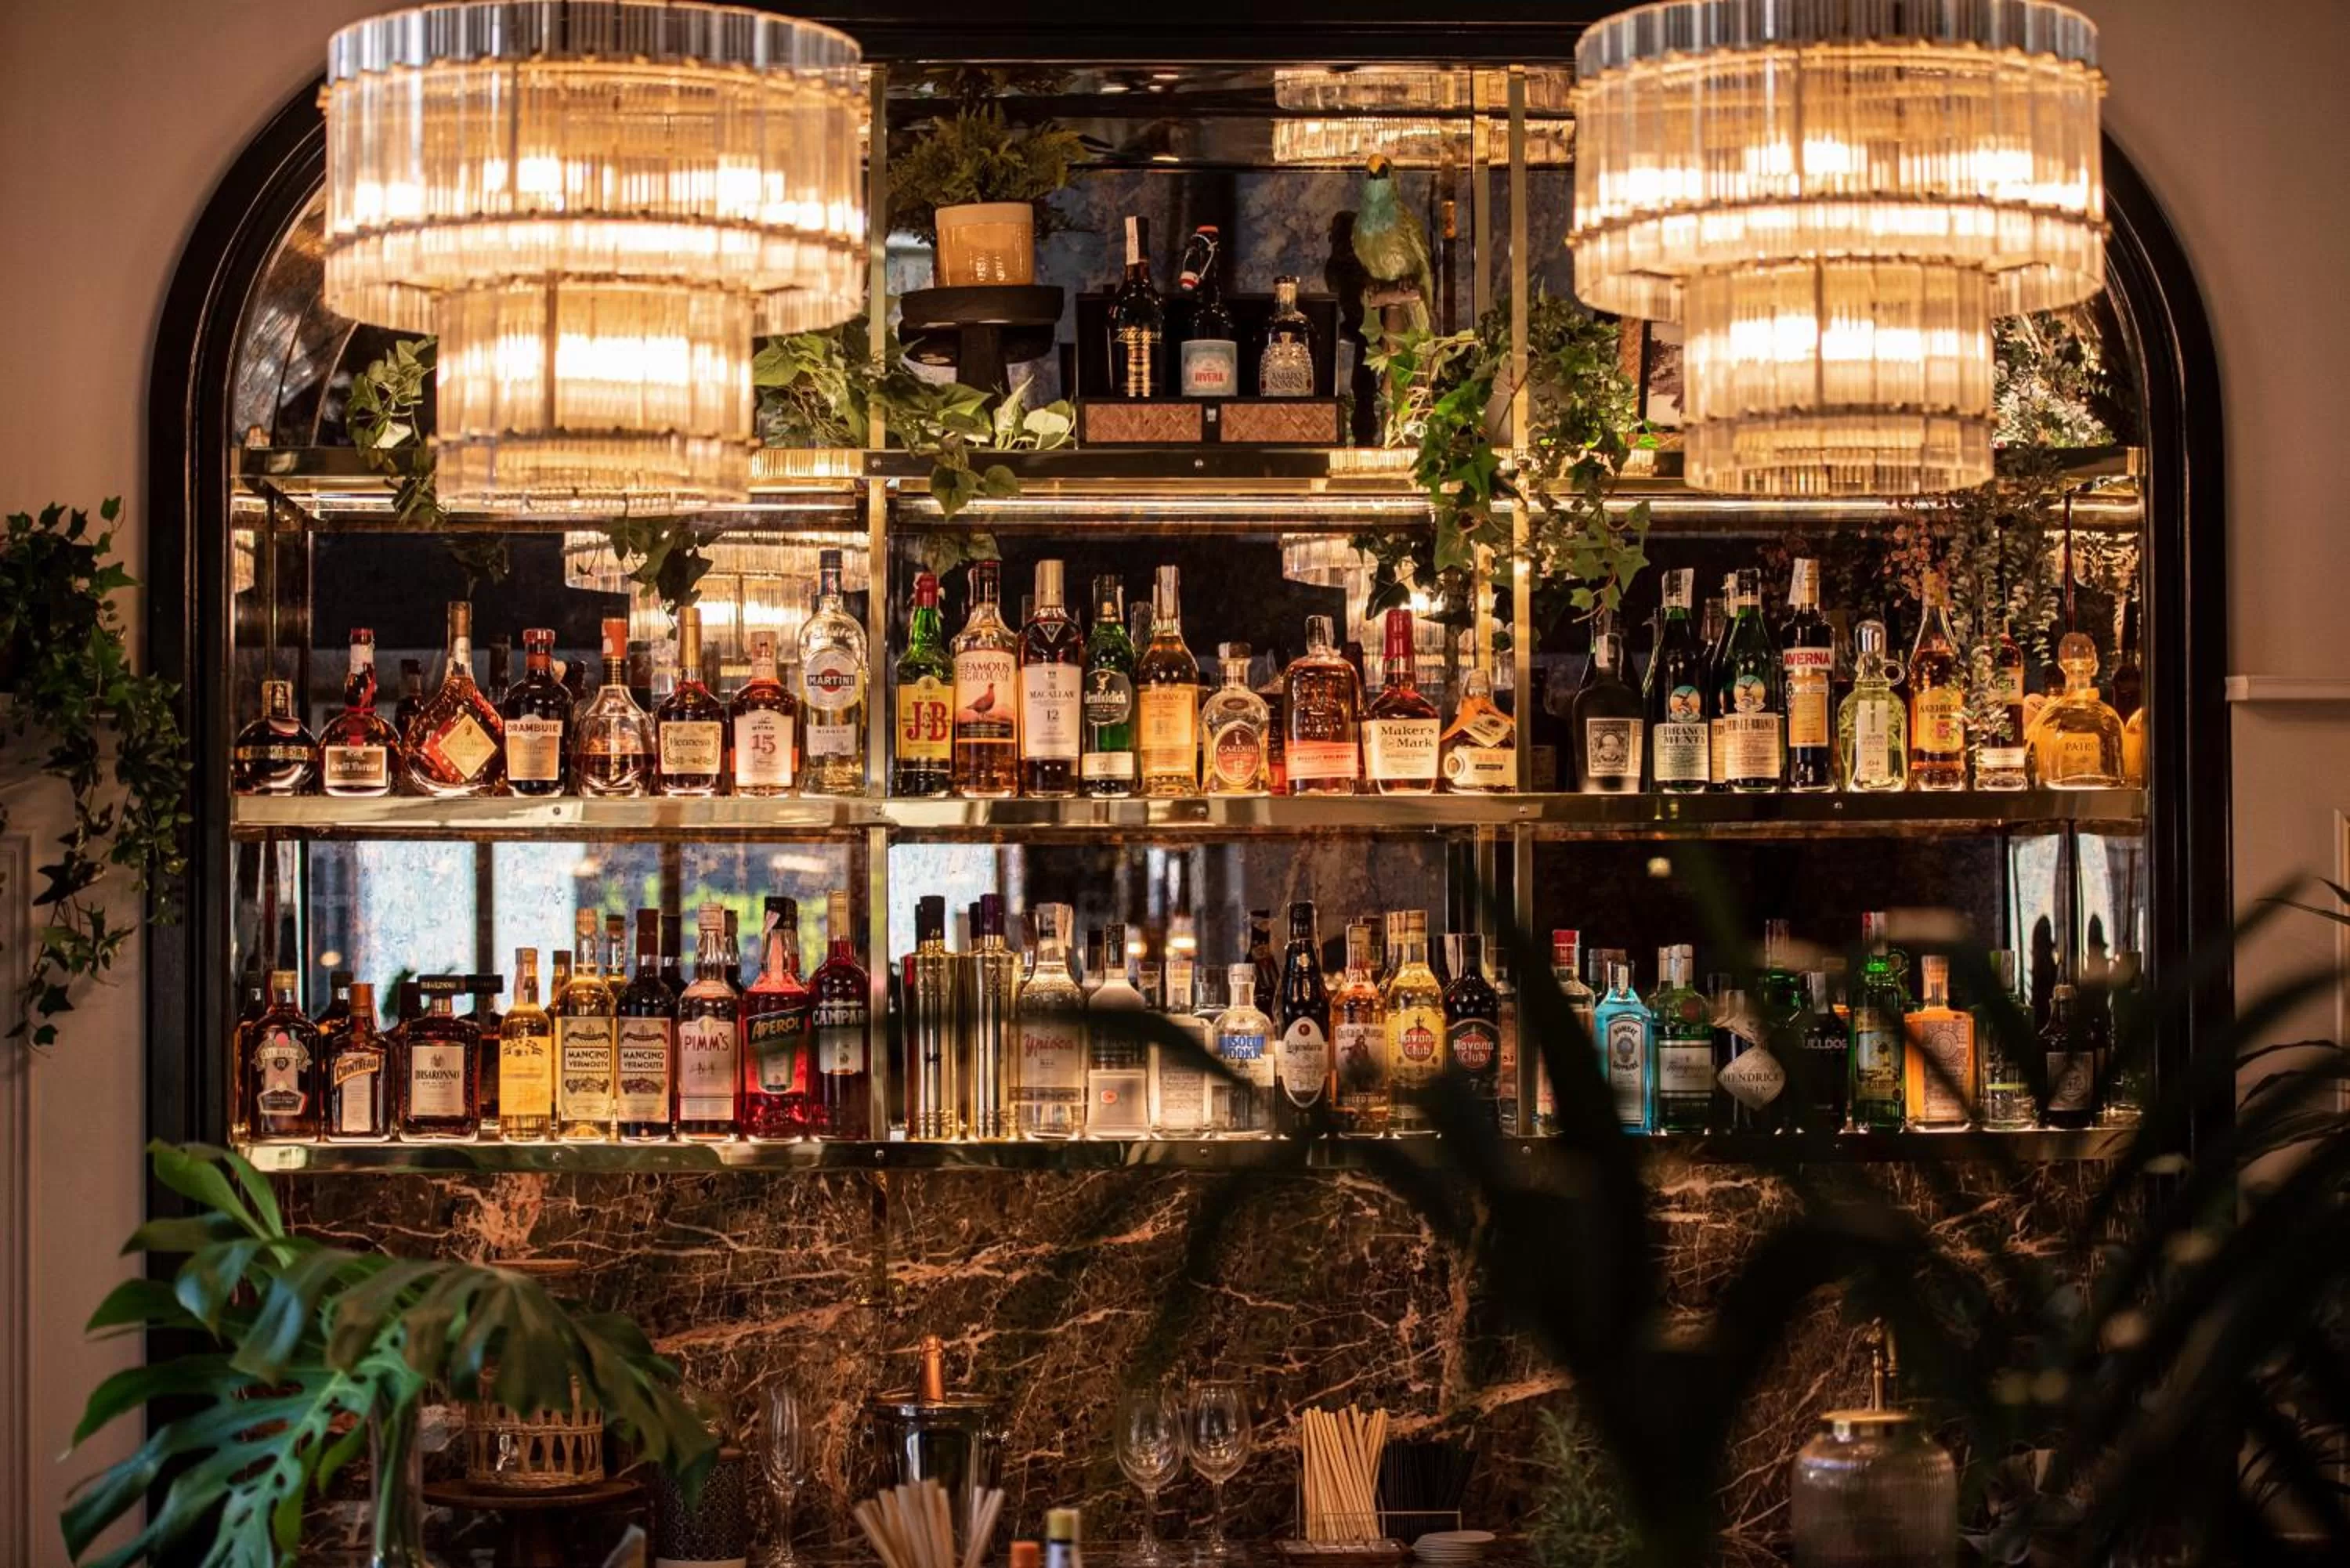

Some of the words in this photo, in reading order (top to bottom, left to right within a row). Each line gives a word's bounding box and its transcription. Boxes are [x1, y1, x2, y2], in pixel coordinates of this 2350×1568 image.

[1784, 652, 1831, 666] AVERNA
[964, 662, 1010, 673] FAMOUS
[808, 676, 854, 686] MARTINI
[1029, 691, 1076, 699] MACALLAN
[1045, 708, 1059, 721] 12
[508, 723, 556, 733] DRAMBUIE
[1380, 726, 1435, 737] Maker's
[751, 734, 777, 754] 15
[1396, 738, 1434, 748] Mark
[812, 1010, 866, 1026] CAMPAR
[684, 1032, 730, 1052] PIMM'S
[1453, 1039, 1494, 1051] Havana
[1801, 1037, 1848, 1050] ULLDOG
[568, 1050, 609, 1060] MANCINO
[1405, 1044, 1430, 1055] Club
[623, 1051, 665, 1060] MANCINO
[1461, 1050, 1486, 1062] Club
[624, 1061, 663, 1070] VERMOUTH
[414, 1069, 461, 1080] DISARONNO
